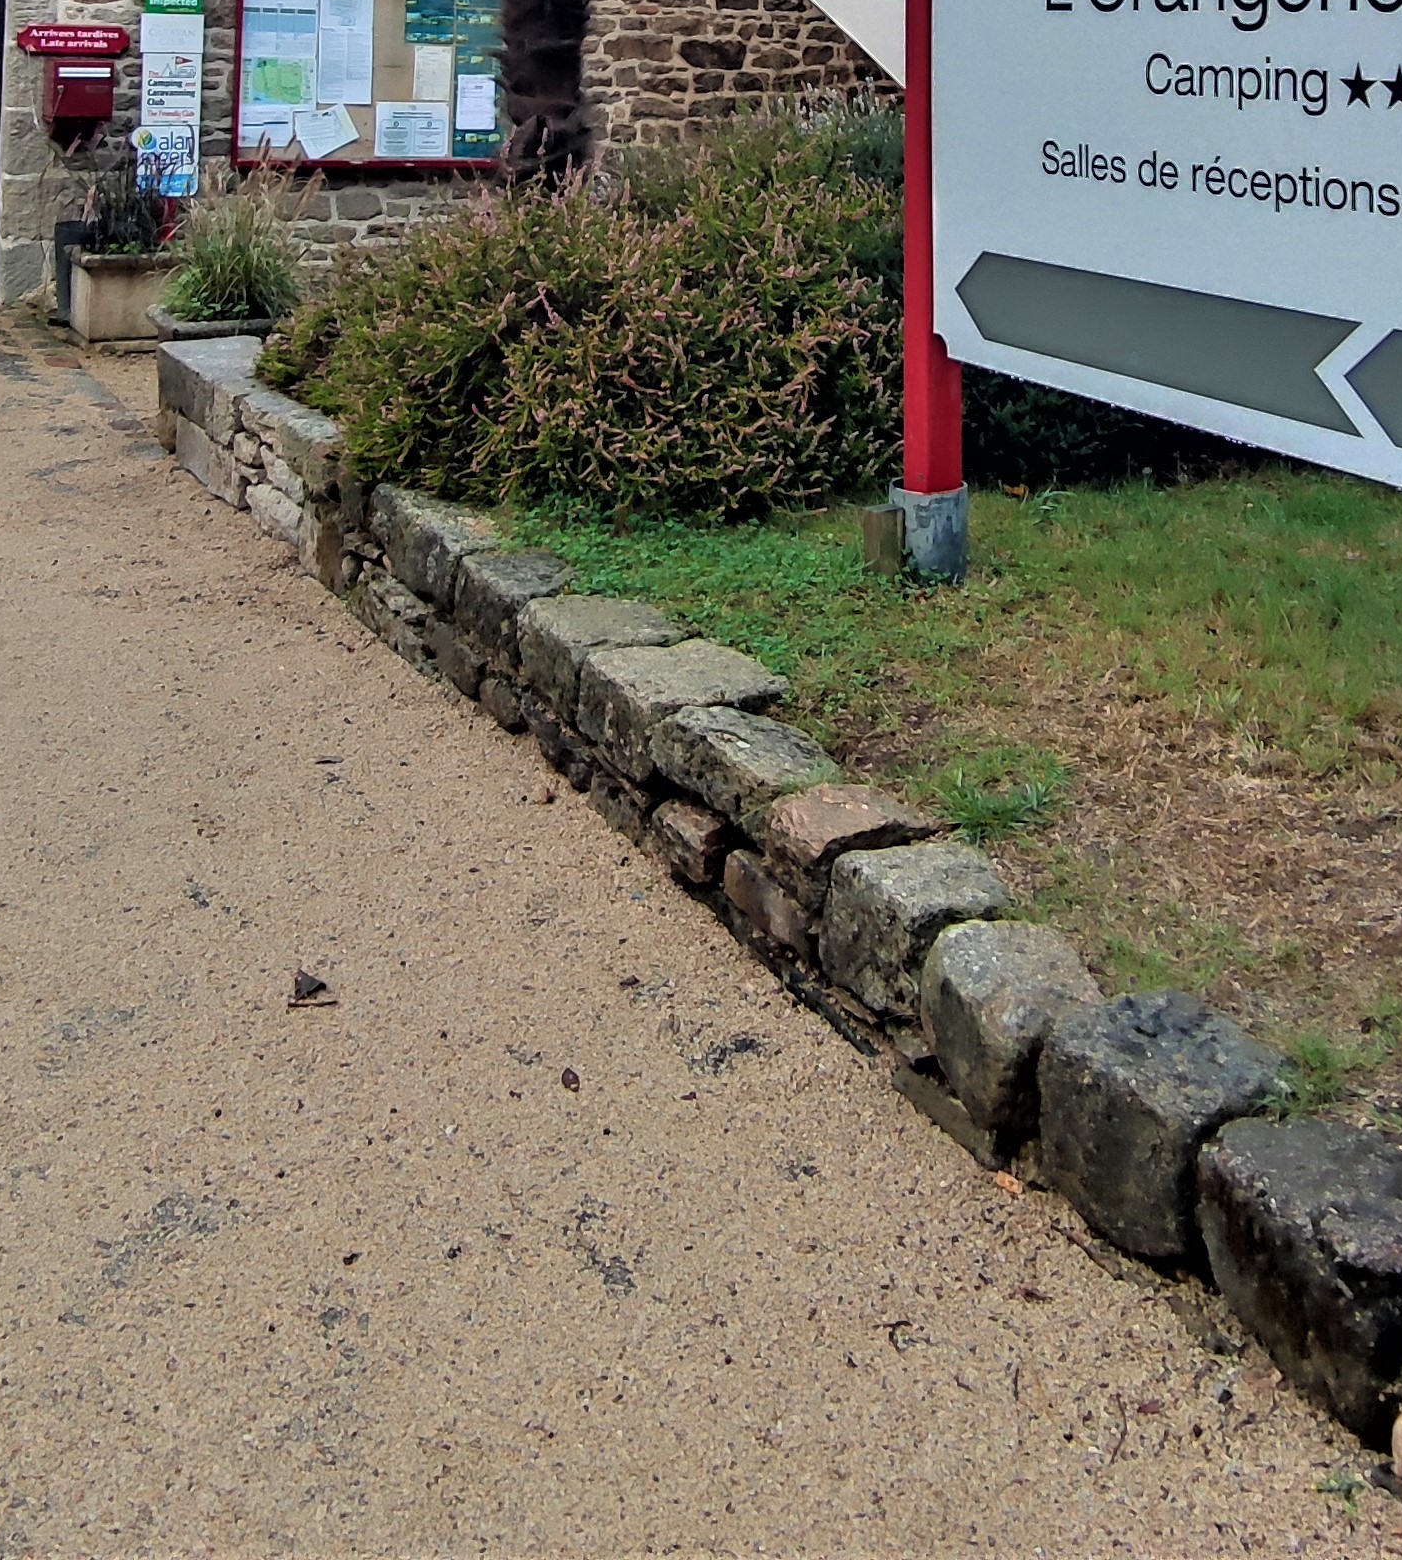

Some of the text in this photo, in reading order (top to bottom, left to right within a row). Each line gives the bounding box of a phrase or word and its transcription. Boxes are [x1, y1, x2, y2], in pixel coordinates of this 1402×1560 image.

[40, 38, 108, 49] Late arrivals
[77, 29, 119, 39] tardives
[1144, 51, 1329, 118] Camping
[1040, 139, 1128, 185] Salles
[1136, 149, 1180, 191] de
